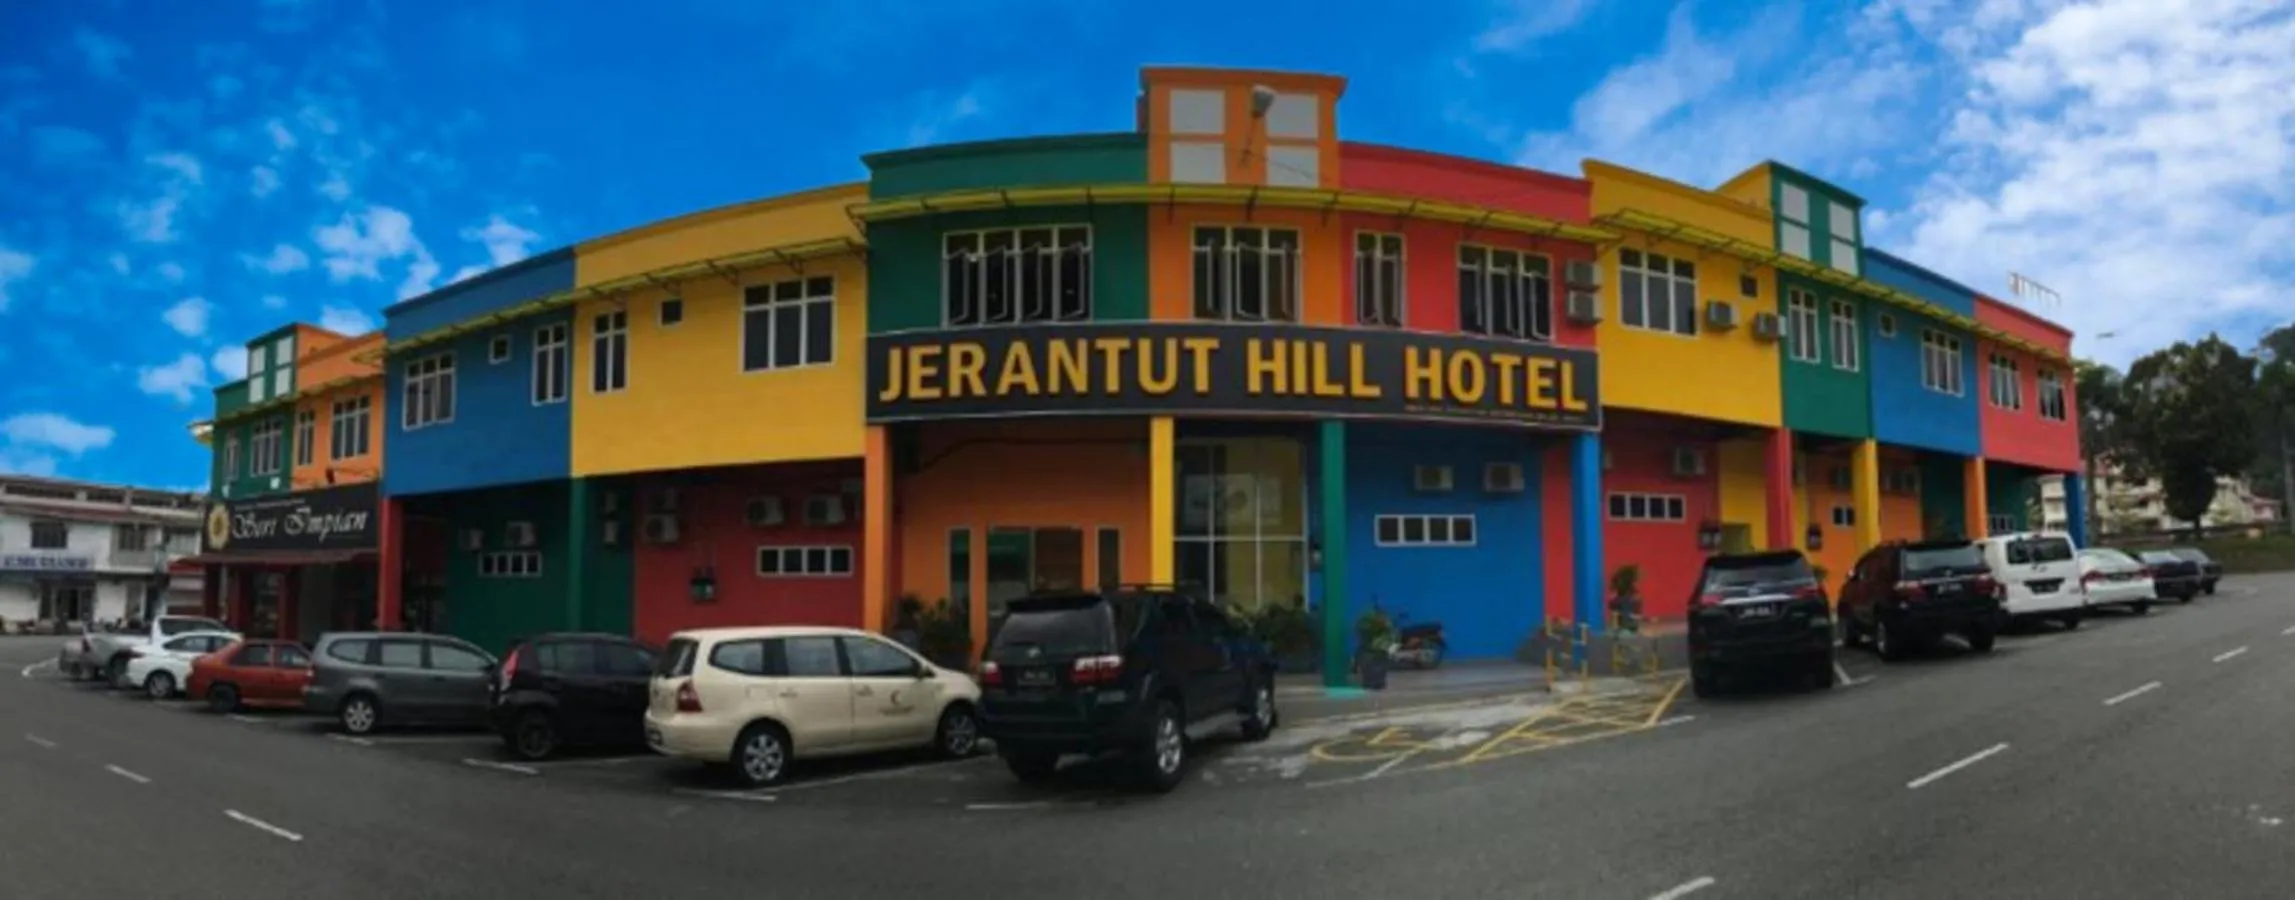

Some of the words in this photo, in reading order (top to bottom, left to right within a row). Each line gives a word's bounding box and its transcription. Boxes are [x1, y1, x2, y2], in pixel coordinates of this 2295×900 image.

[878, 337, 1220, 402] JERANTUT
[1247, 338, 1382, 397] HILL
[1404, 345, 1588, 411] HOTEL
